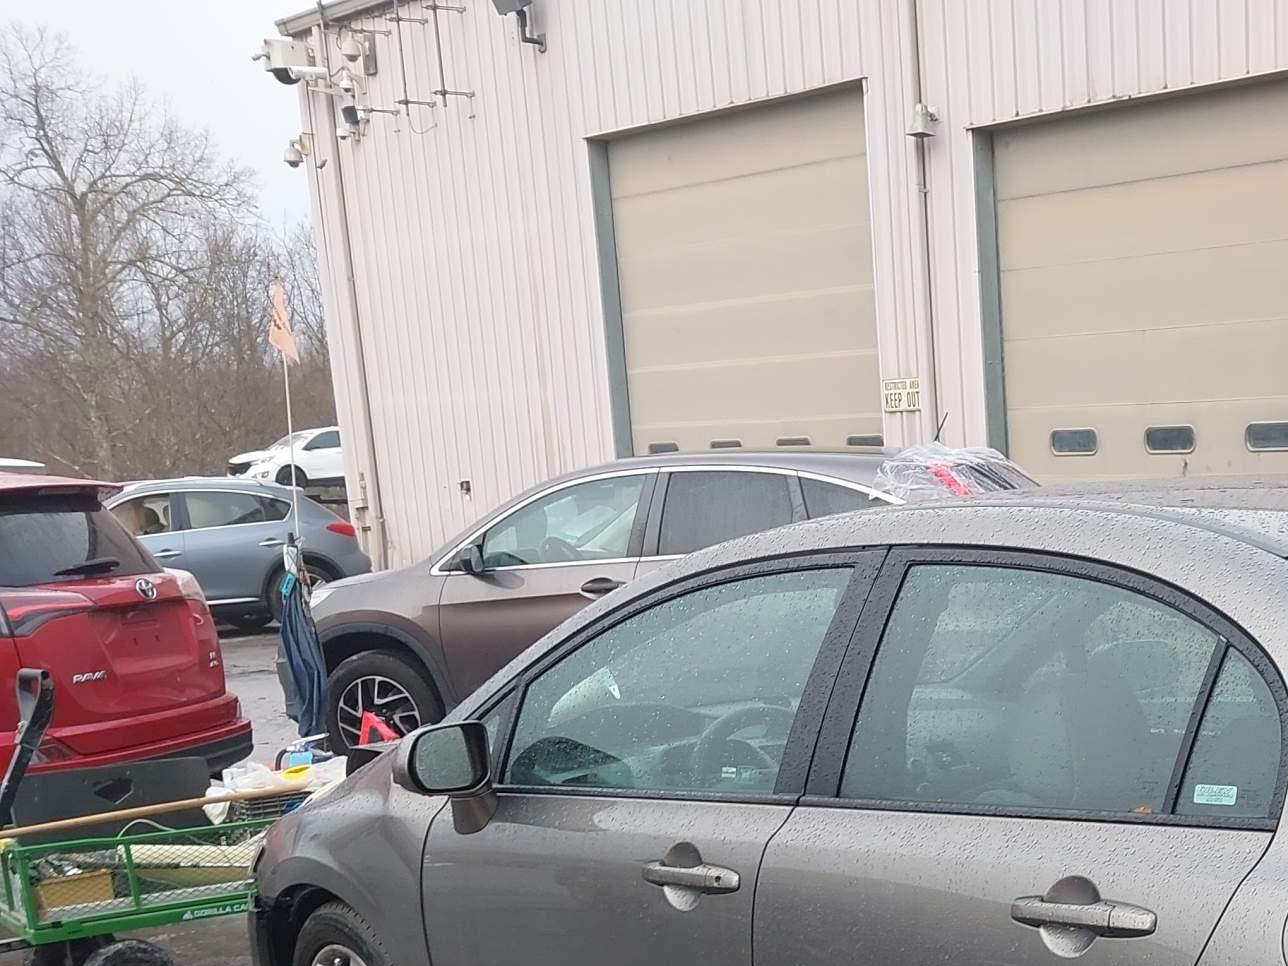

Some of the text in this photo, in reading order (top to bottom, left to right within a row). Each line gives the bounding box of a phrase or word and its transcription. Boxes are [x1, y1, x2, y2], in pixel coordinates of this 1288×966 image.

[910, 380, 920, 389] AREA
[885, 391, 920, 408] KEEP OUT
[233, 903, 249, 912] CA
